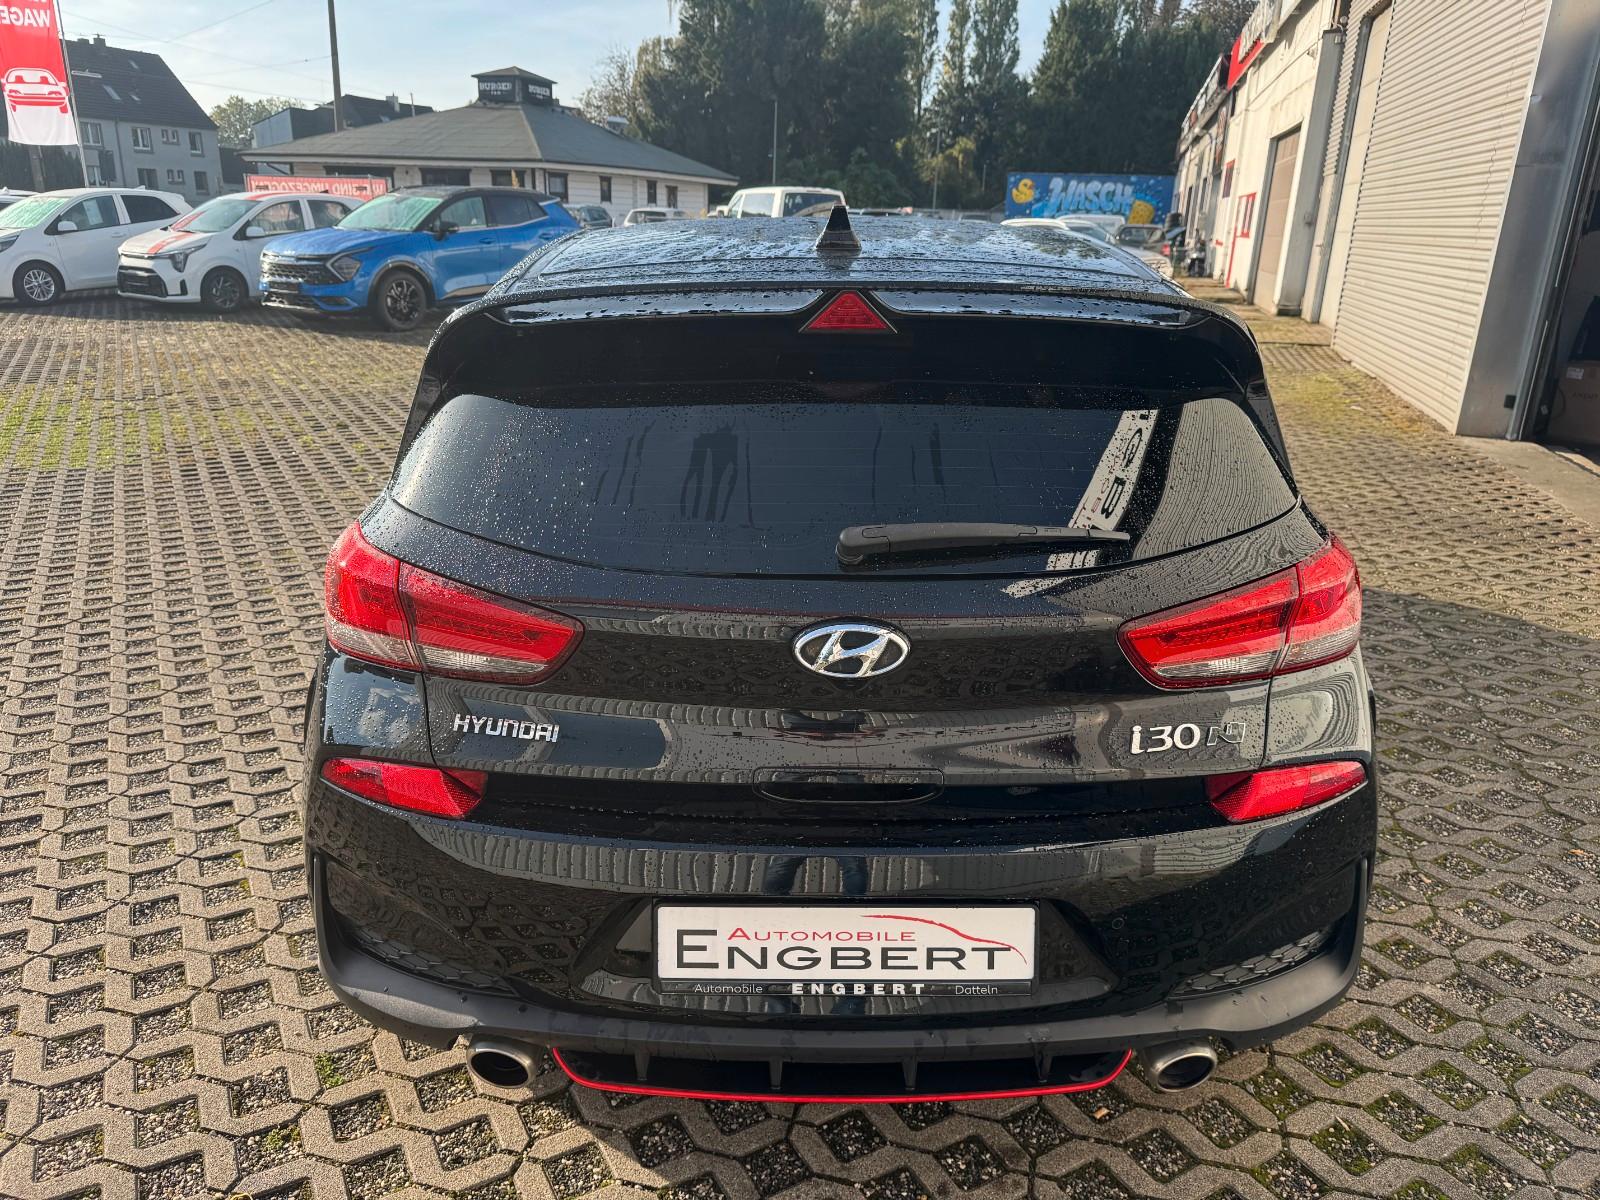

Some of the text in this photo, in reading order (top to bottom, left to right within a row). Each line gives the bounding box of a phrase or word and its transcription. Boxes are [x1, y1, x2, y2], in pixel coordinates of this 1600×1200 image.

[1048, 177, 1135, 216] WASCH
[453, 714, 560, 742] HYUNDAI
[1131, 723, 1201, 755] i30
[1207, 722, 1246, 746] N
[727, 927, 916, 942] AUTOMOBILE
[676, 929, 1012, 971] ENGBERT
[694, 982, 999, 996] Automobile ENGBERT Datteln
